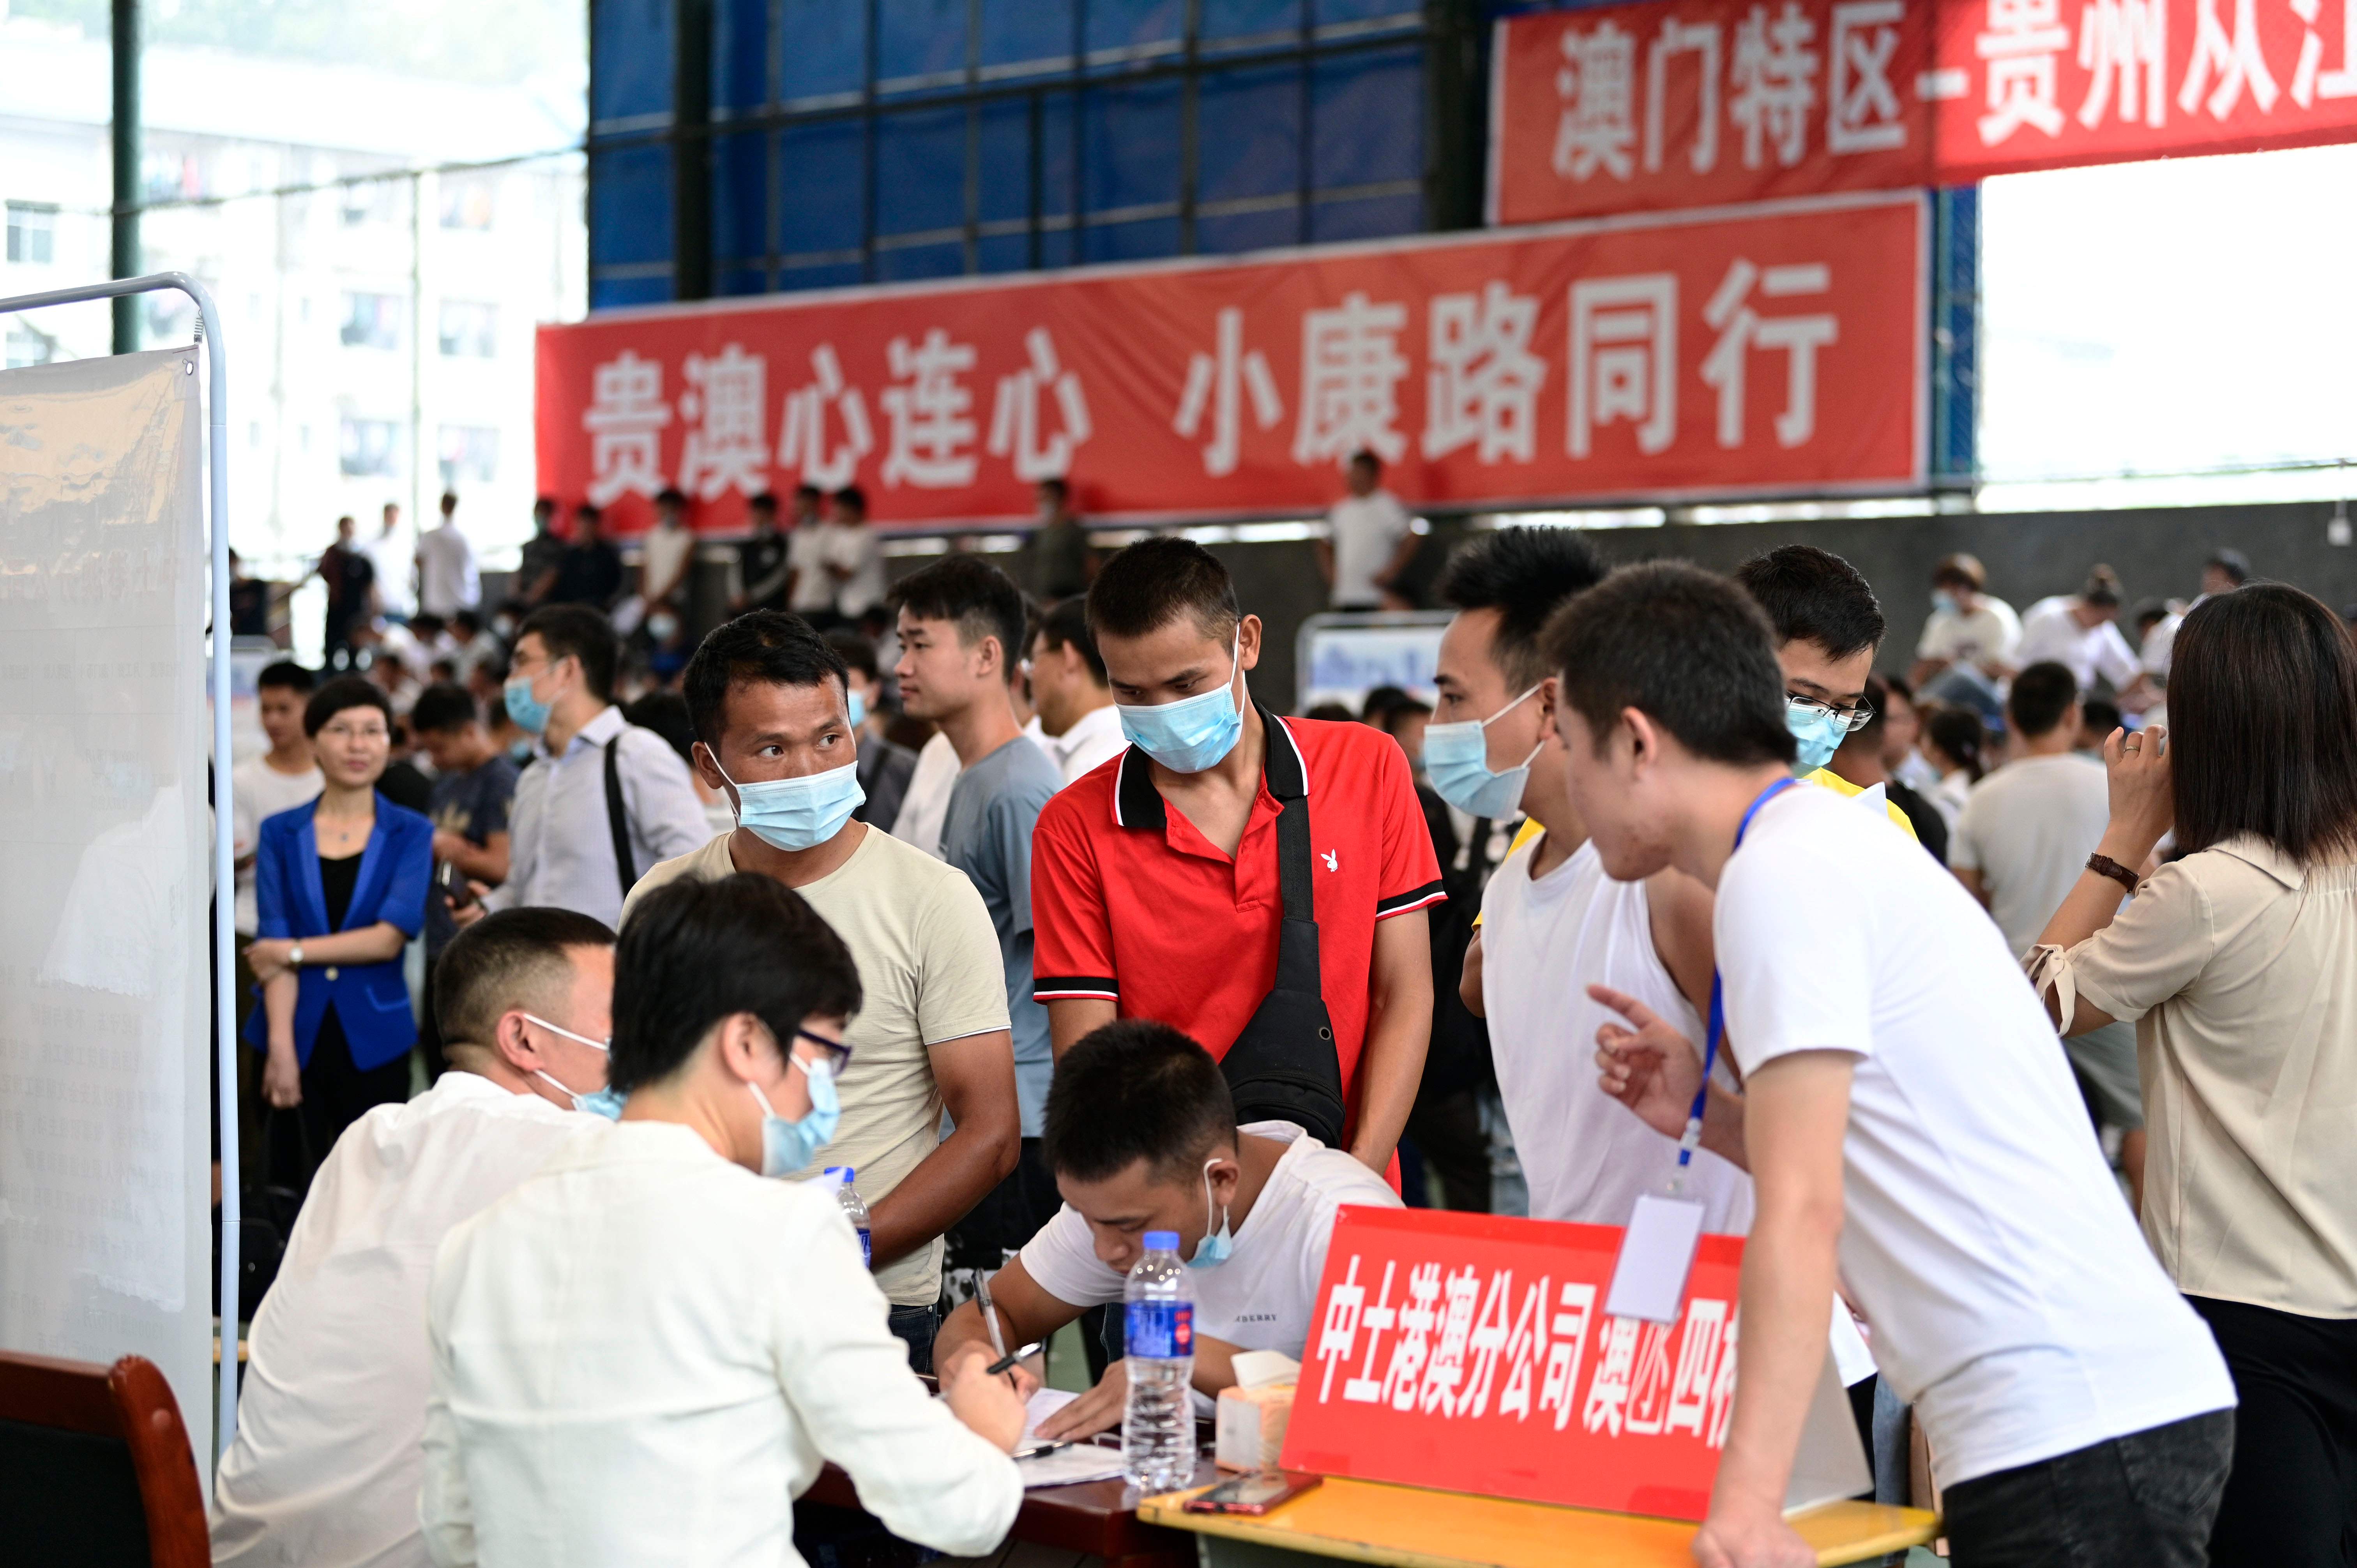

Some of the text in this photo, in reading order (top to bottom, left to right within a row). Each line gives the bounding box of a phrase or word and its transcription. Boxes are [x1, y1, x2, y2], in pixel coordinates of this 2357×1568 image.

[583, 257, 1838, 507] 贵澳心连心 小康路同行
[1316, 1254, 1597, 1431] 中土港澳分公司
